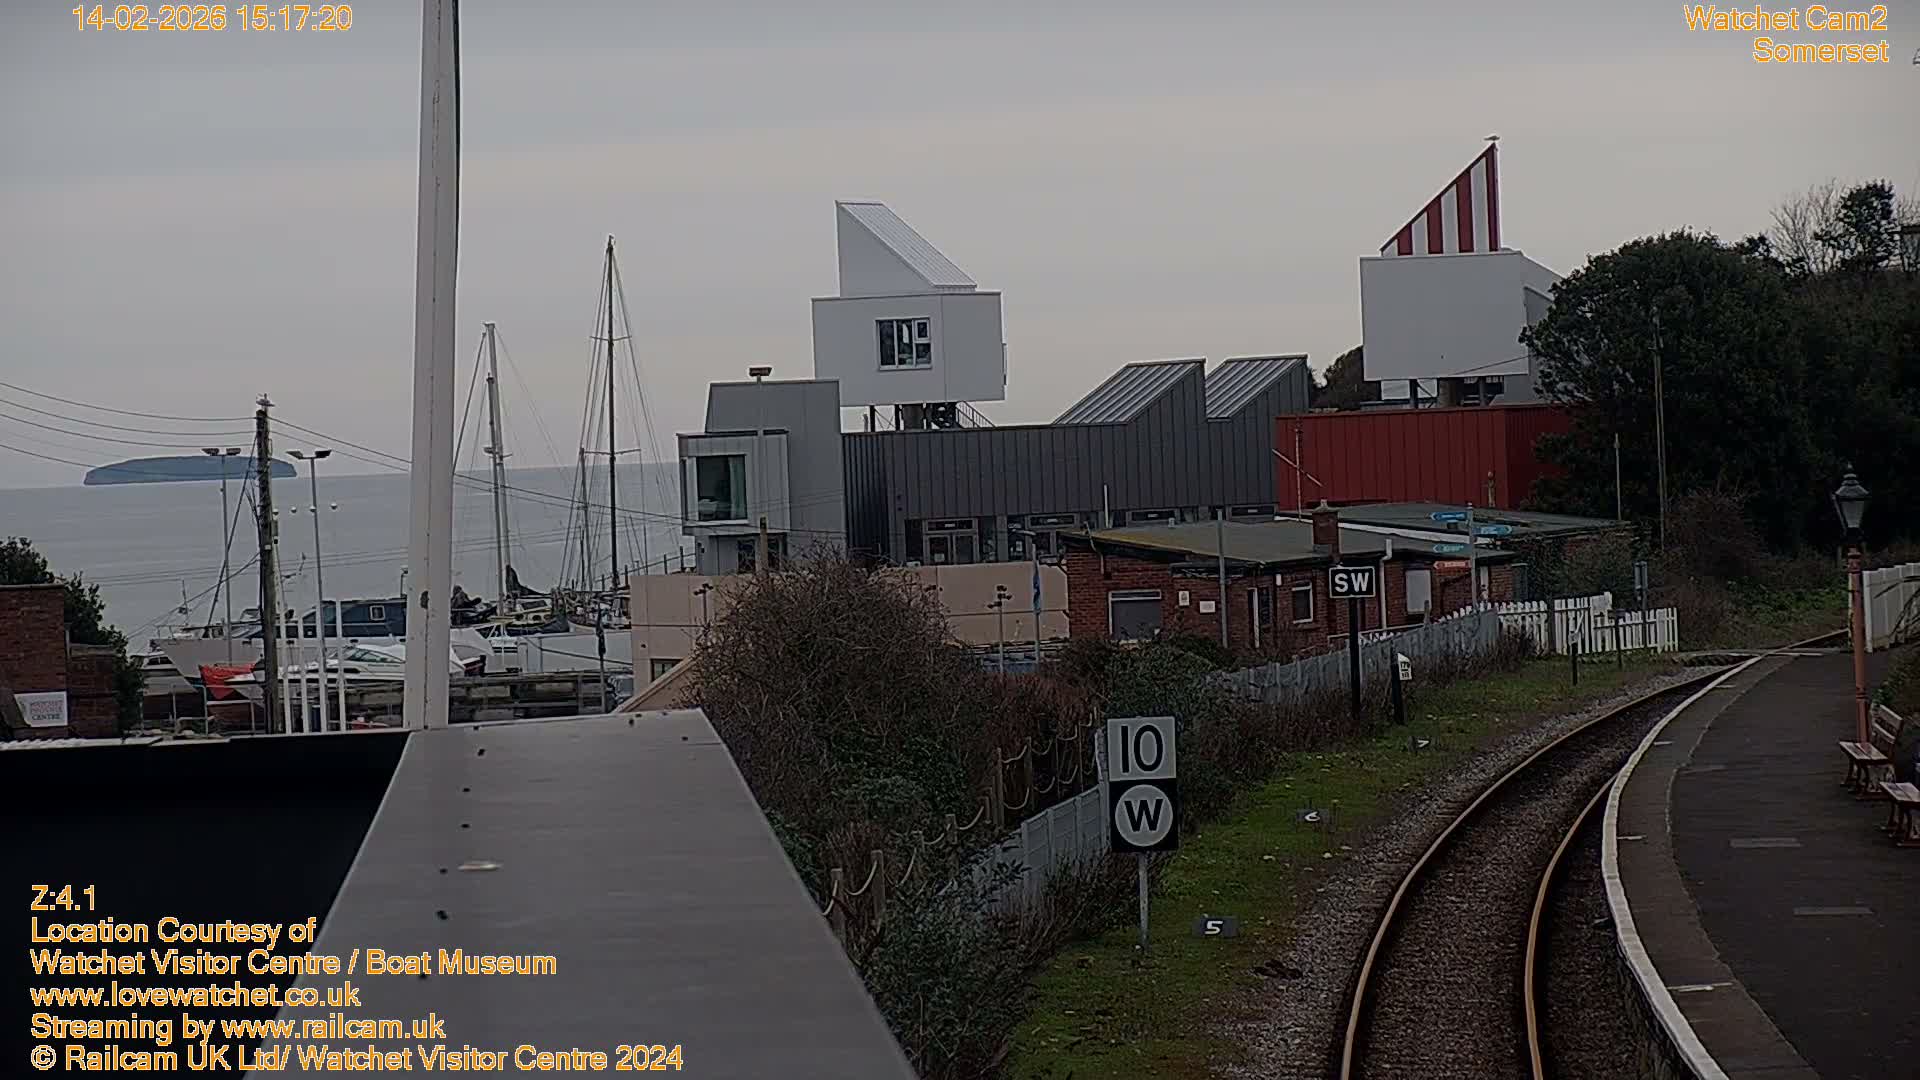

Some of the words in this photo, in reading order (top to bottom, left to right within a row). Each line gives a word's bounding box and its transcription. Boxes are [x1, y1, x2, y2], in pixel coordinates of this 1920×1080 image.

[1334, 571, 1369, 593] SW
[1120, 724, 1164, 773] 10
[1124, 798, 1164, 833] W
[1204, 919, 1224, 935] 5
